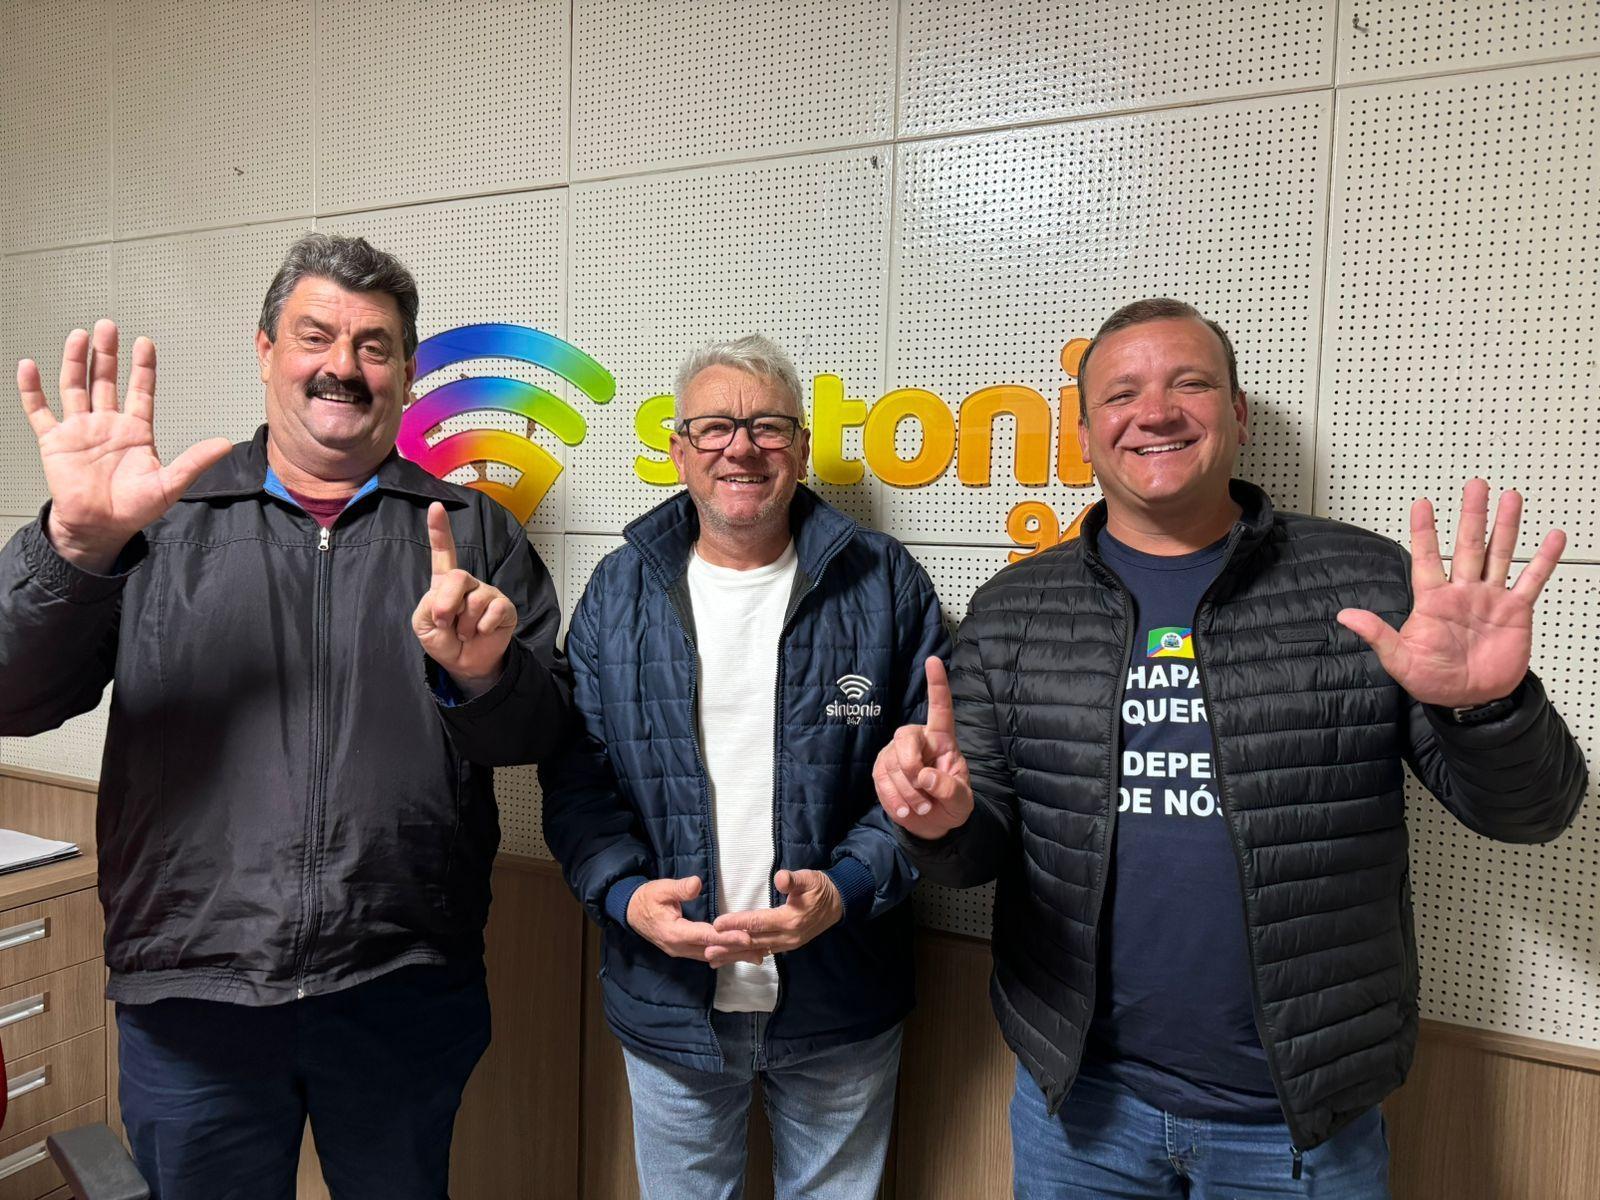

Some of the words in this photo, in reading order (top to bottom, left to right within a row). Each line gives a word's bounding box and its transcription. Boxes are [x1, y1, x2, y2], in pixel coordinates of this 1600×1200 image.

[634, 338, 1094, 487] stoni
[825, 700, 881, 717] sintonia
[1123, 751, 1216, 778] DEPE
